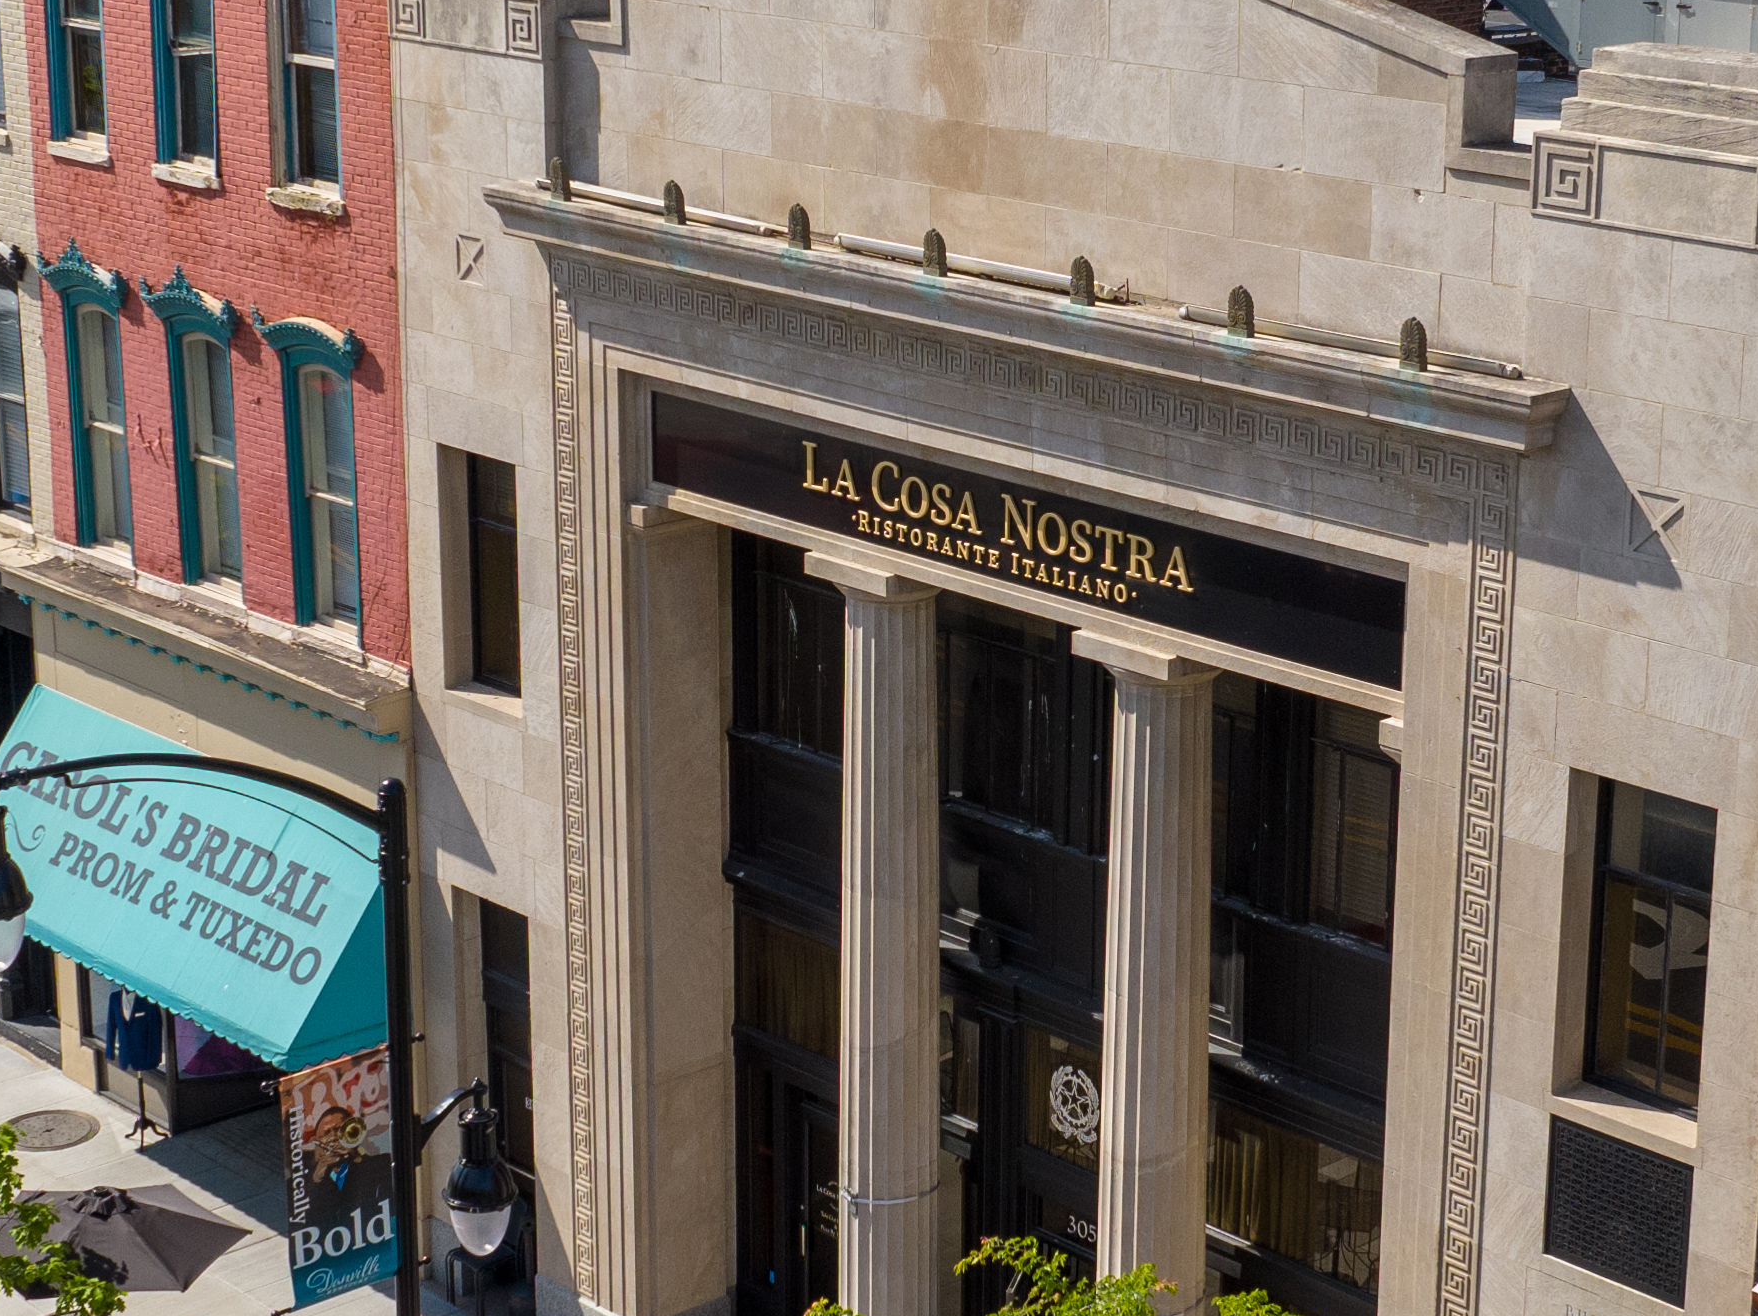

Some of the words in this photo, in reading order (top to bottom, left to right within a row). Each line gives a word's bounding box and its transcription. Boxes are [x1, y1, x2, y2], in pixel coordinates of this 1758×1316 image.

[871, 460, 983, 536] COSA
[1000, 493, 1195, 593] NOSTRA
[48, 831, 154, 905] PROM
[149, 880, 179, 920] &
[178, 891, 323, 985] TUXEDO
[159, 813, 331, 927] BRIDAL
[289, 1104, 311, 1225] Historically
[291, 1198, 395, 1270] Bold
[1067, 1215, 1097, 1243] 305
